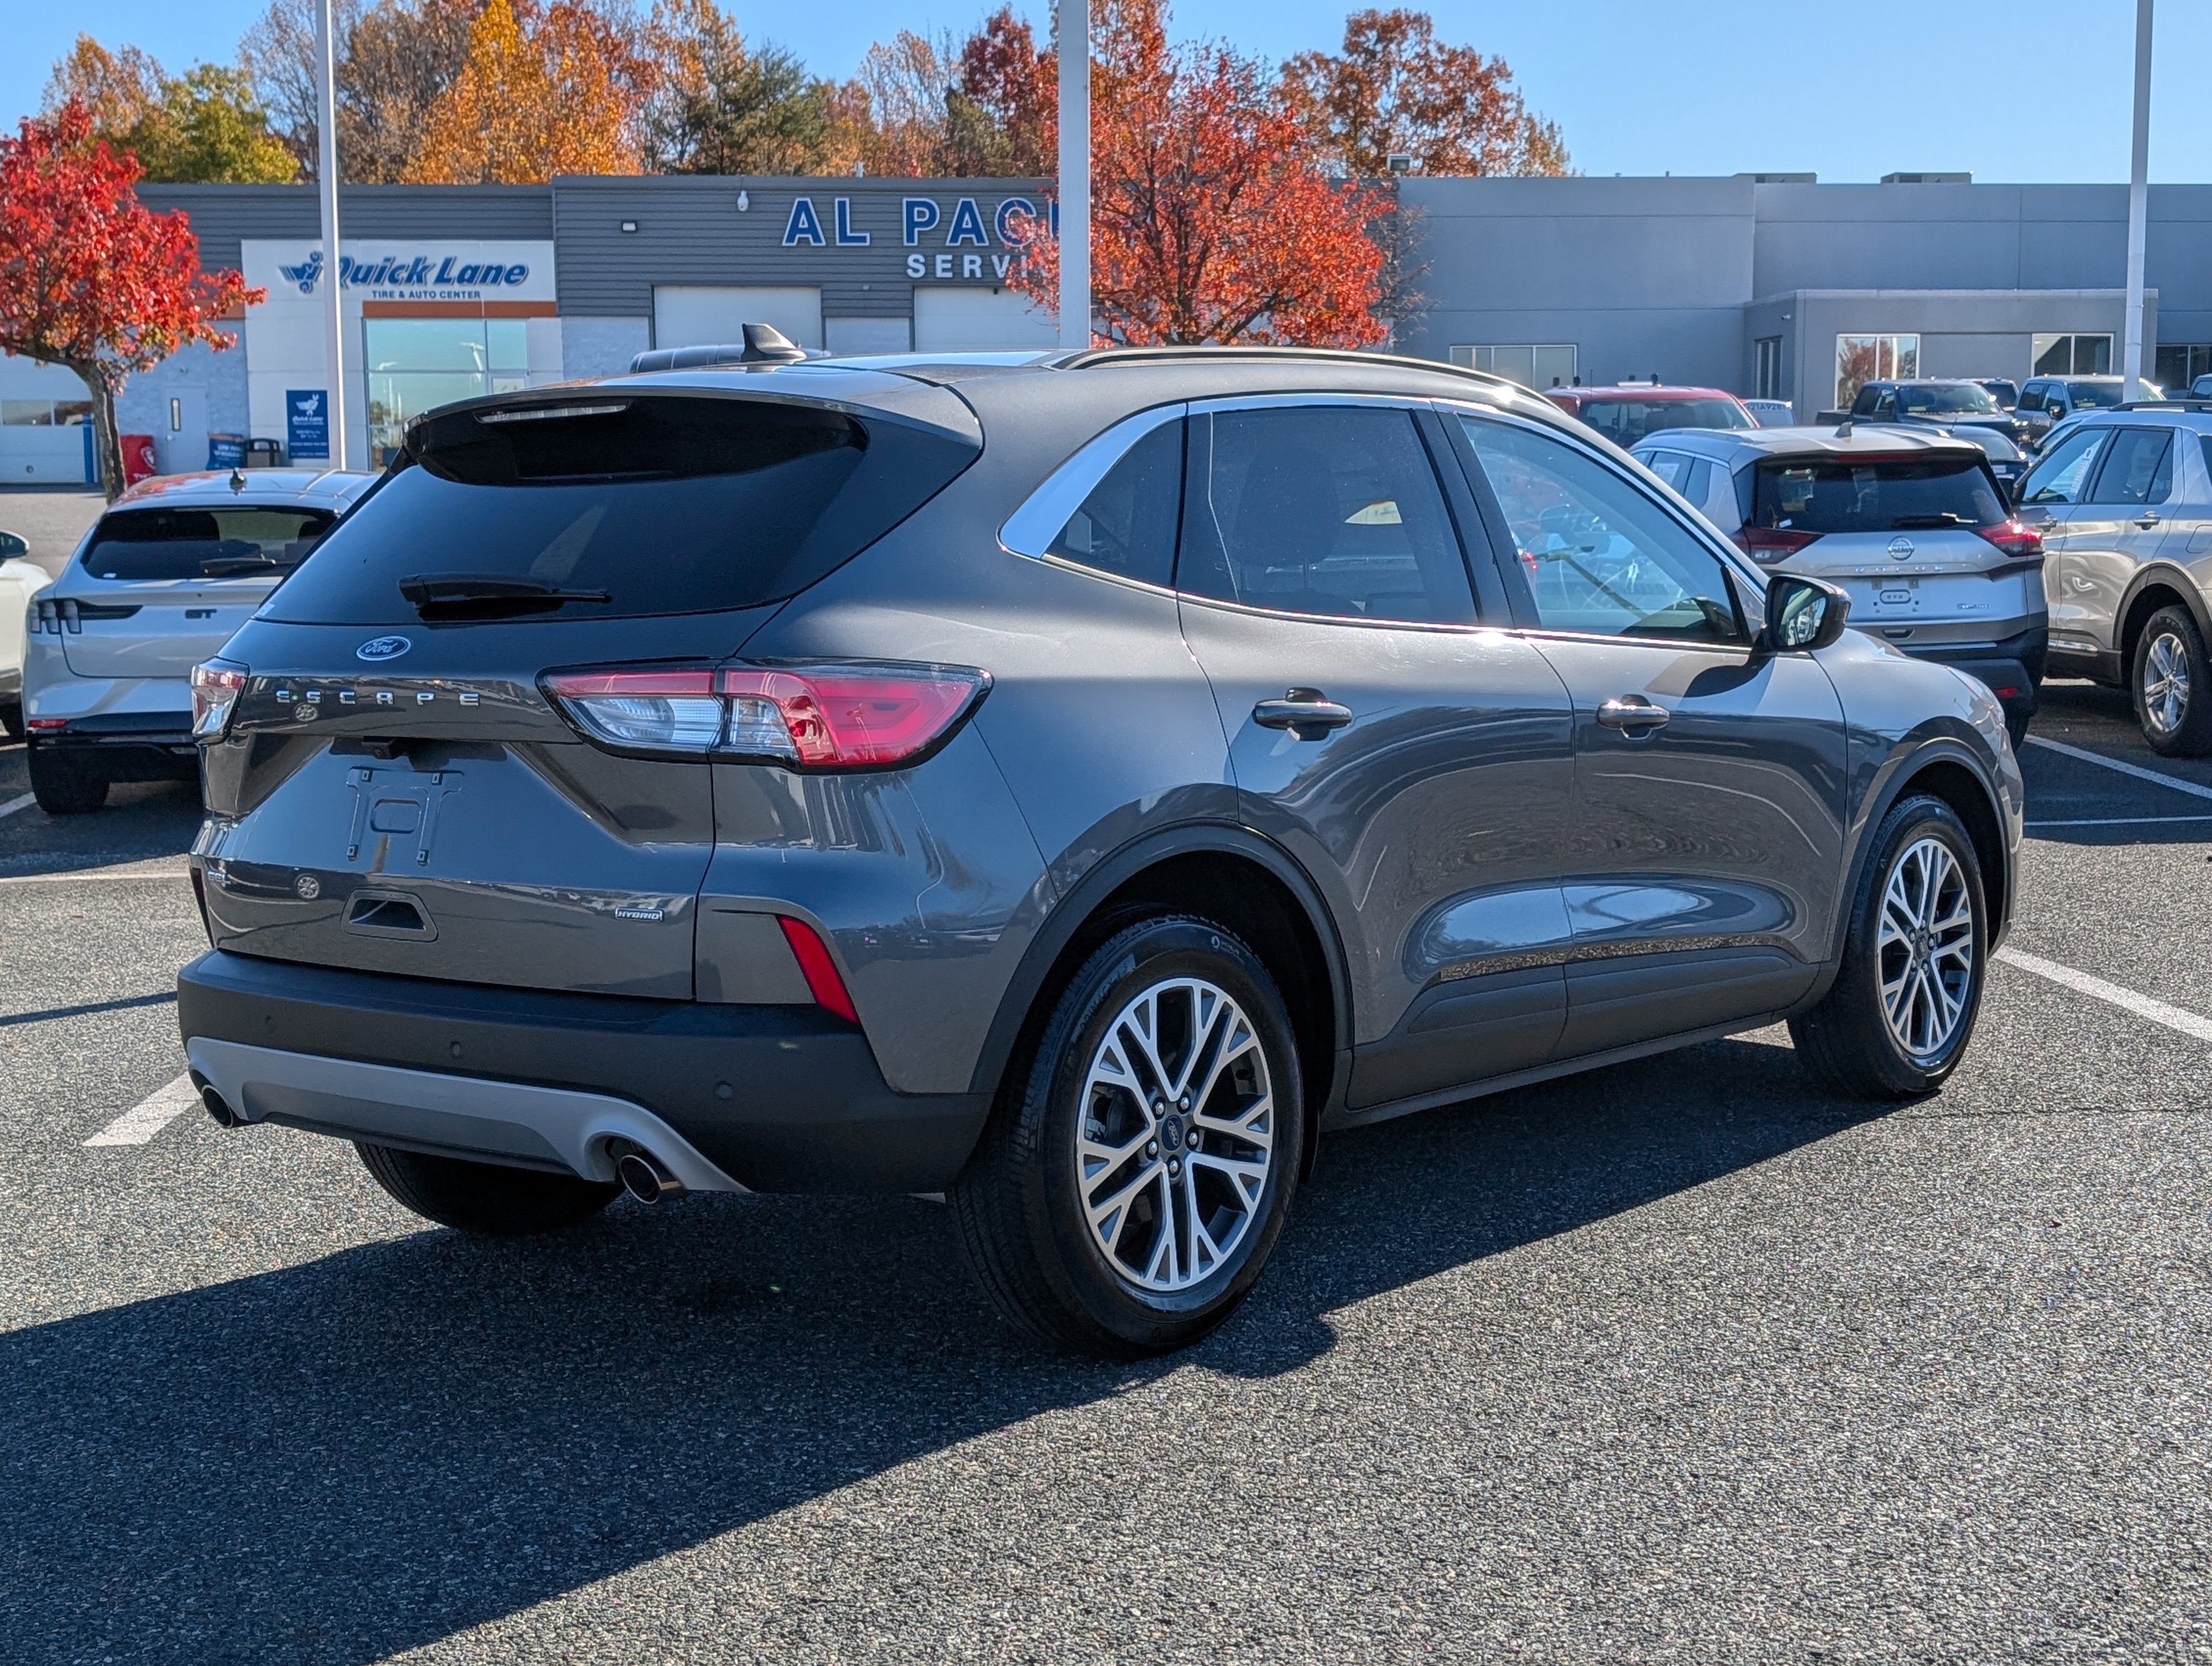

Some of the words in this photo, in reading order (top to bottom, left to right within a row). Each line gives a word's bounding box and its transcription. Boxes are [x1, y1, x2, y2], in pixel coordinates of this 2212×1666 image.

[782, 198, 870, 246] AL
[434, 256, 529, 286] Lane
[372, 290, 395, 298] TIRE
[398, 290, 406, 298] &
[408, 290, 436, 299] AUTO
[439, 290, 481, 299] CENTER
[185, 608, 217, 619] GT
[275, 690, 480, 706] ESCAPE
[618, 911, 660, 920] HYBRID
